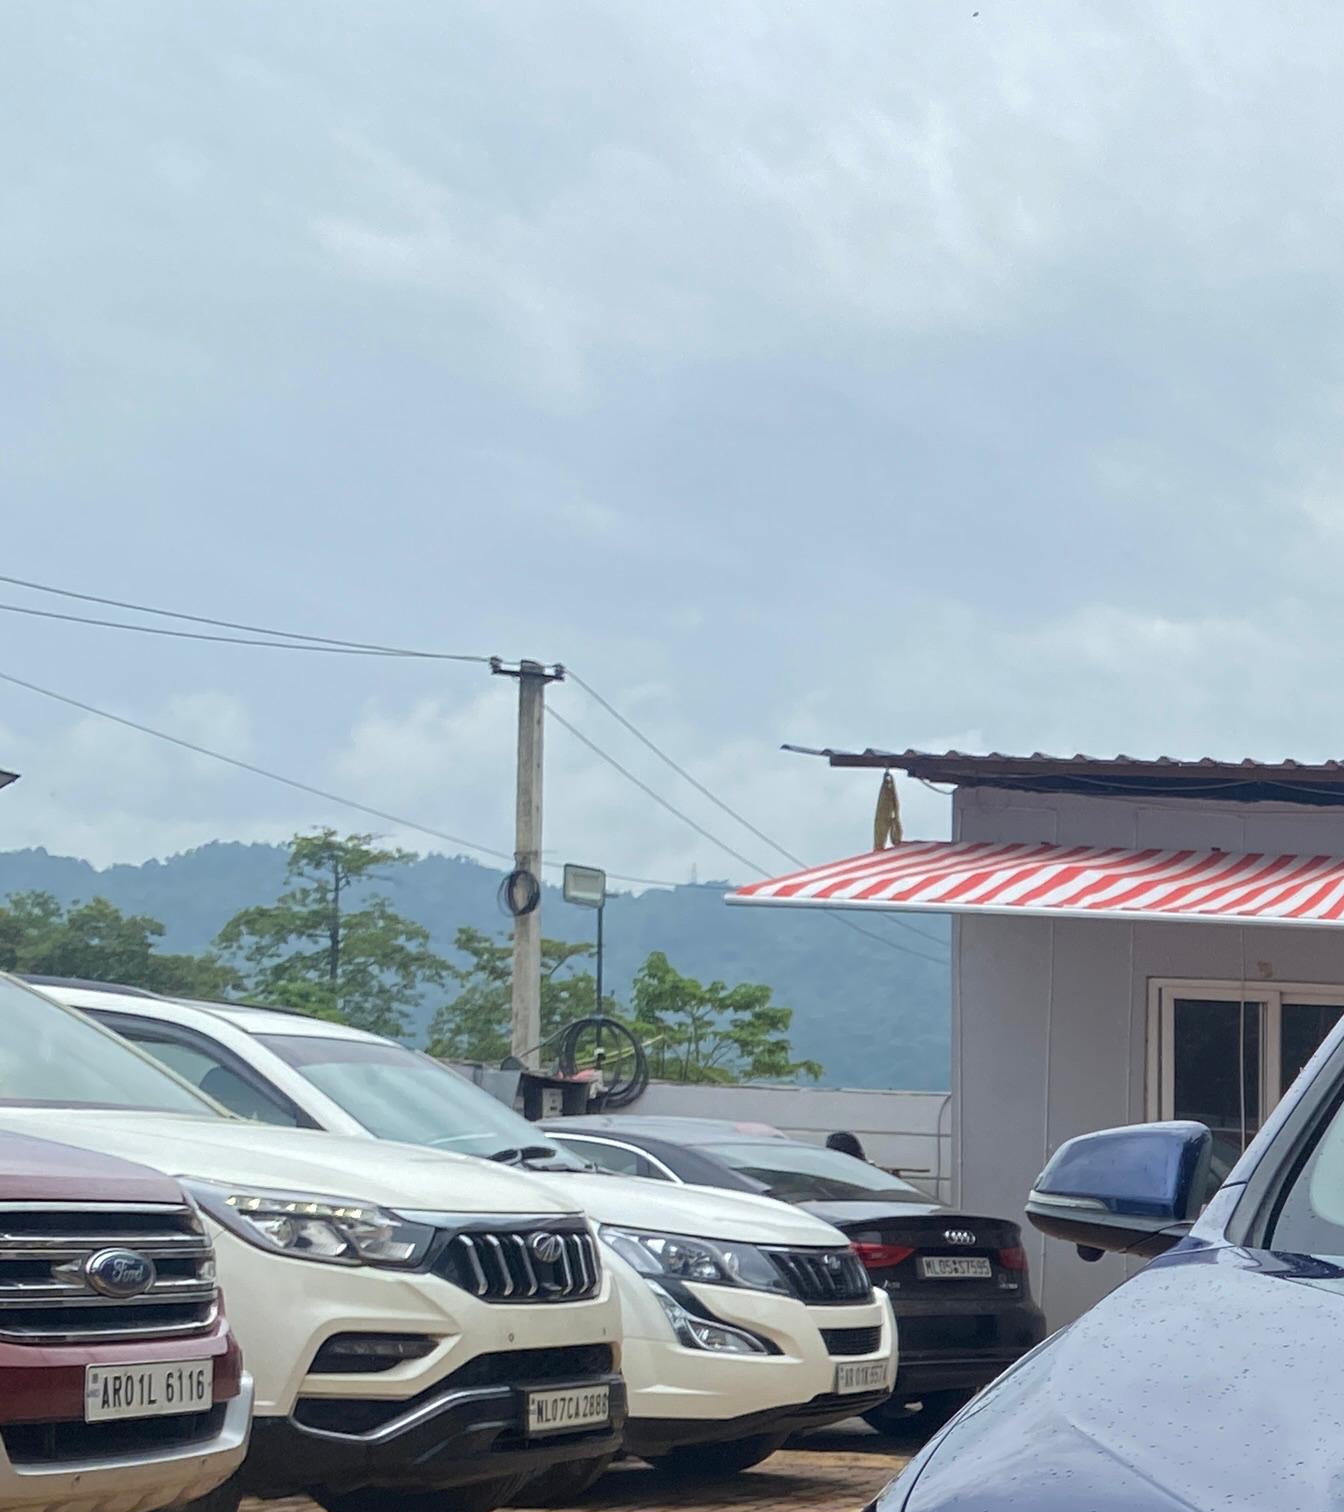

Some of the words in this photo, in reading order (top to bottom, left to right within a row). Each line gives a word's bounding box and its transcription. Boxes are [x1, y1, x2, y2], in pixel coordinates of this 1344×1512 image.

[111, 1258, 144, 1283] Ford
[102, 1374, 157, 1409] AR01L
[165, 1370, 205, 1403] 6116
